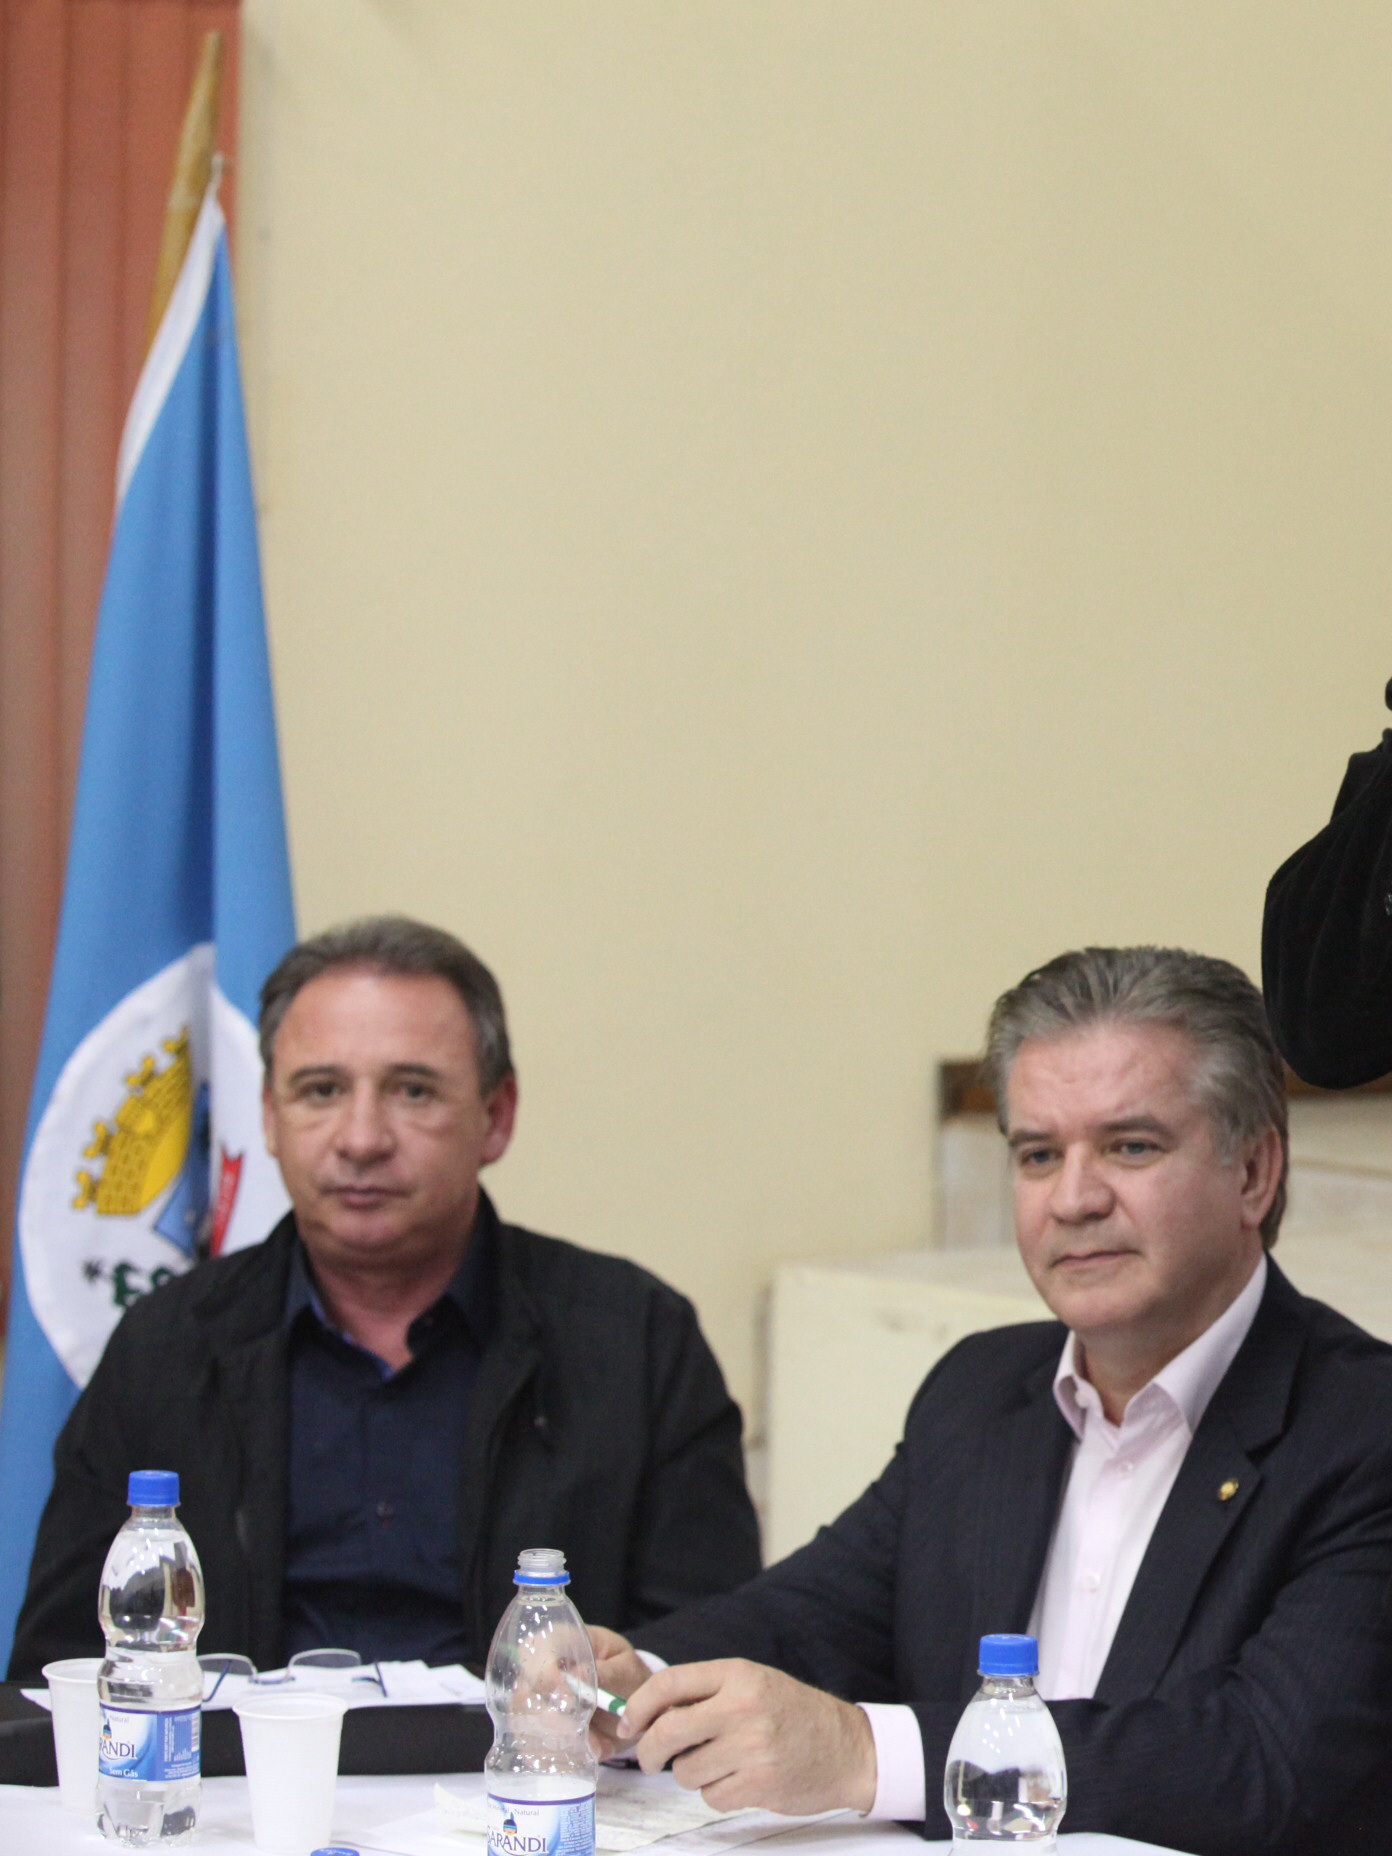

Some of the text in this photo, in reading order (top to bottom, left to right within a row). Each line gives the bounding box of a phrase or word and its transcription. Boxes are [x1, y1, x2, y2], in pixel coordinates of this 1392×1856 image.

[123, 1768, 138, 1777] Gás
[513, 1807, 540, 1816] Natural
[487, 1825, 547, 1853] SARANDI
